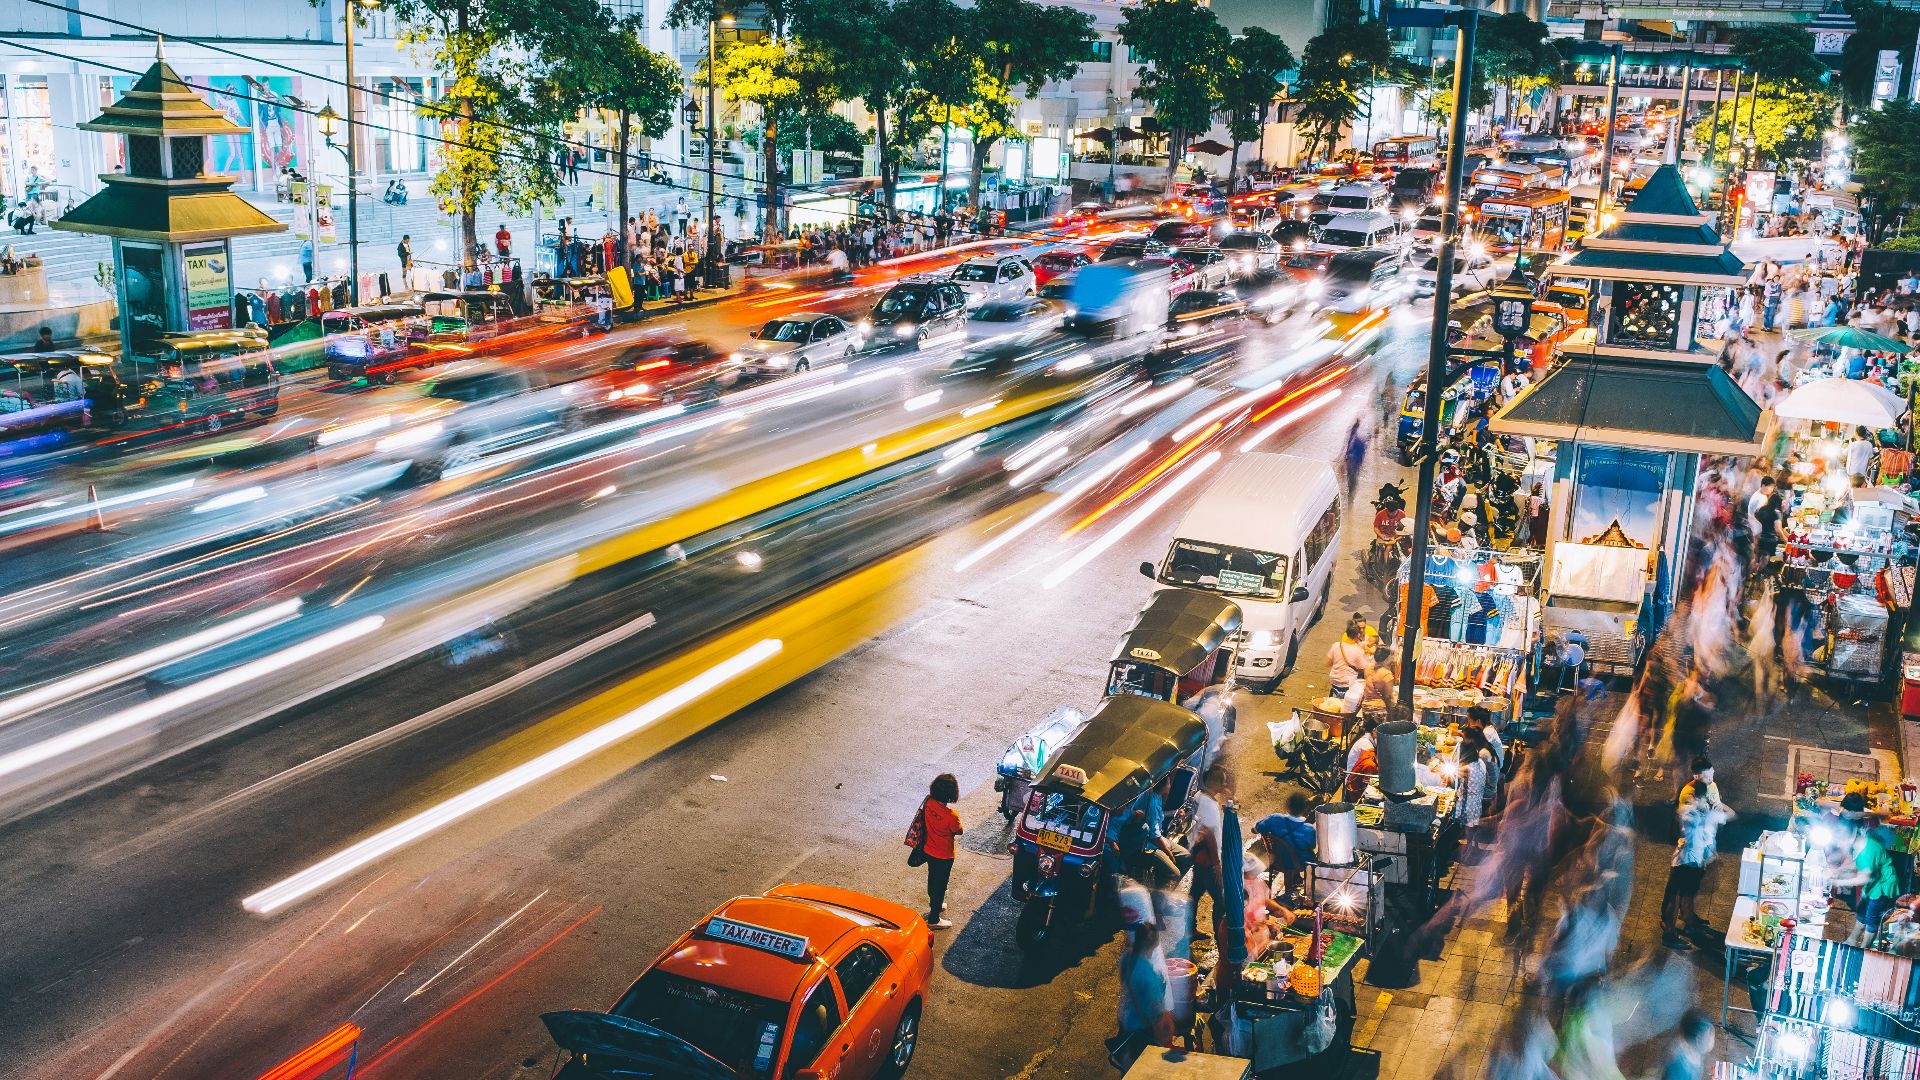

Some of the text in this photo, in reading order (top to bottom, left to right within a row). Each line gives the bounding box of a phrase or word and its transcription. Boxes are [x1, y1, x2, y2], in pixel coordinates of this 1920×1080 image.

[1672, 9, 1704, 19] Bangkok
[187, 258, 207, 270] TAXI
[1060, 767, 1081, 780] TAXI
[721, 924, 793, 952] TAXI-METER
[1793, 953, 1814, 967] 50
